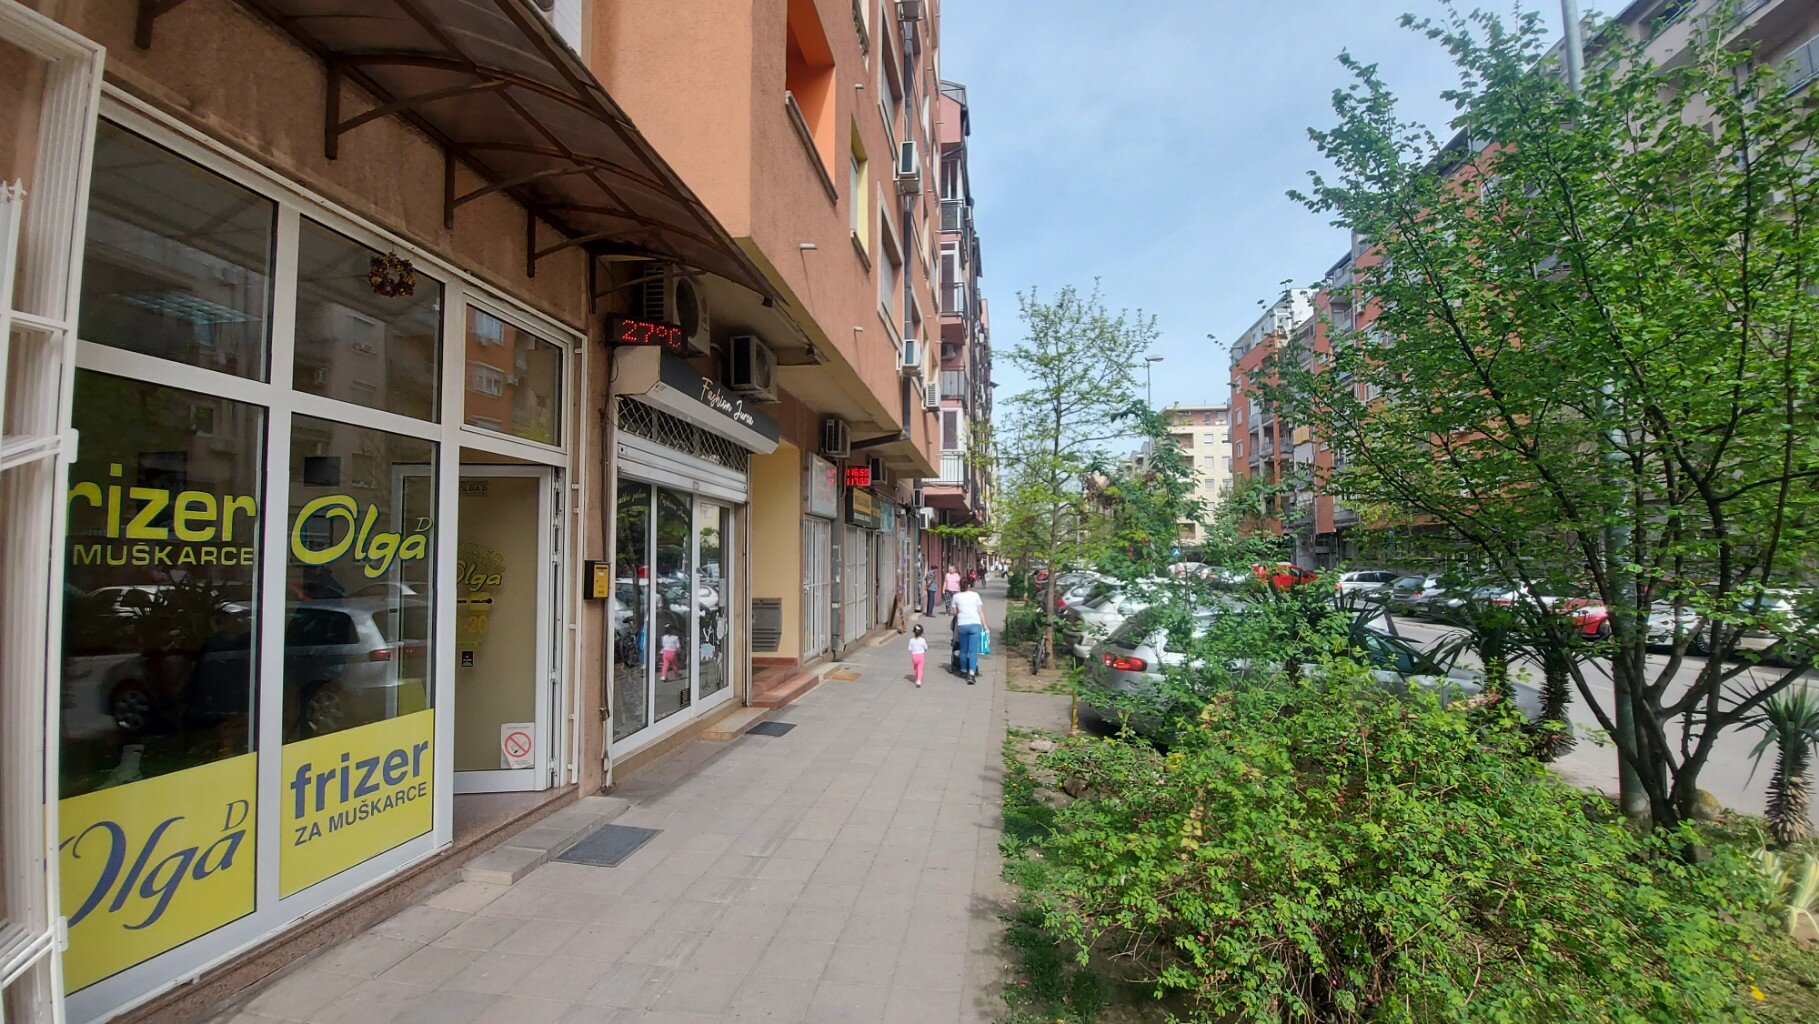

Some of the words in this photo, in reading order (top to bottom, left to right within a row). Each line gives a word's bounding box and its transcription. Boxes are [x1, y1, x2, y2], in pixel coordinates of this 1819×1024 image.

[700, 376, 732, 412] Fashion
[67, 463, 257, 542] rizer
[72, 541, 254, 566] MUŠKARCE
[290, 495, 427, 579] Olga
[414, 516, 433, 531] D
[290, 740, 429, 819] frizer
[221, 799, 250, 832] D
[294, 824, 323, 847] ZA
[328, 781, 428, 834] MUŠKARCE
